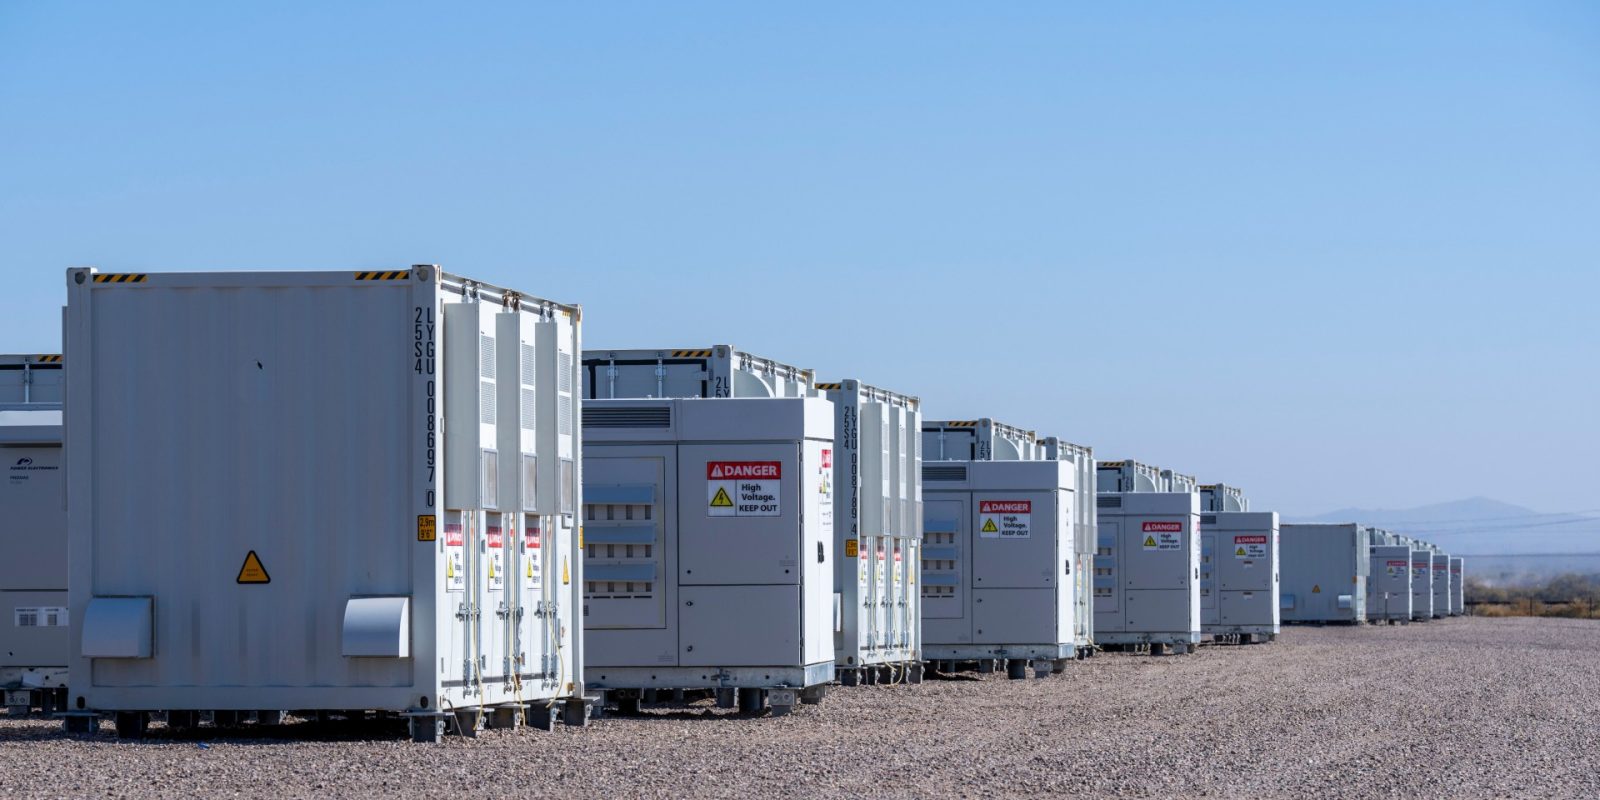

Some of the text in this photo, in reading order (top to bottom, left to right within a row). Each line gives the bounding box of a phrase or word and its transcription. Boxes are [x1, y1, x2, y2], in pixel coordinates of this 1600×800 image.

[414, 306, 423, 375] 25S4
[426, 307, 435, 507] LYGU 008697 0
[724, 465, 777, 476] DANGER
[741, 483, 761, 492] High
[741, 493, 776, 502] Voltage.
[739, 504, 778, 512] KEEP OUT
[992, 503, 1028, 511] DANGER
